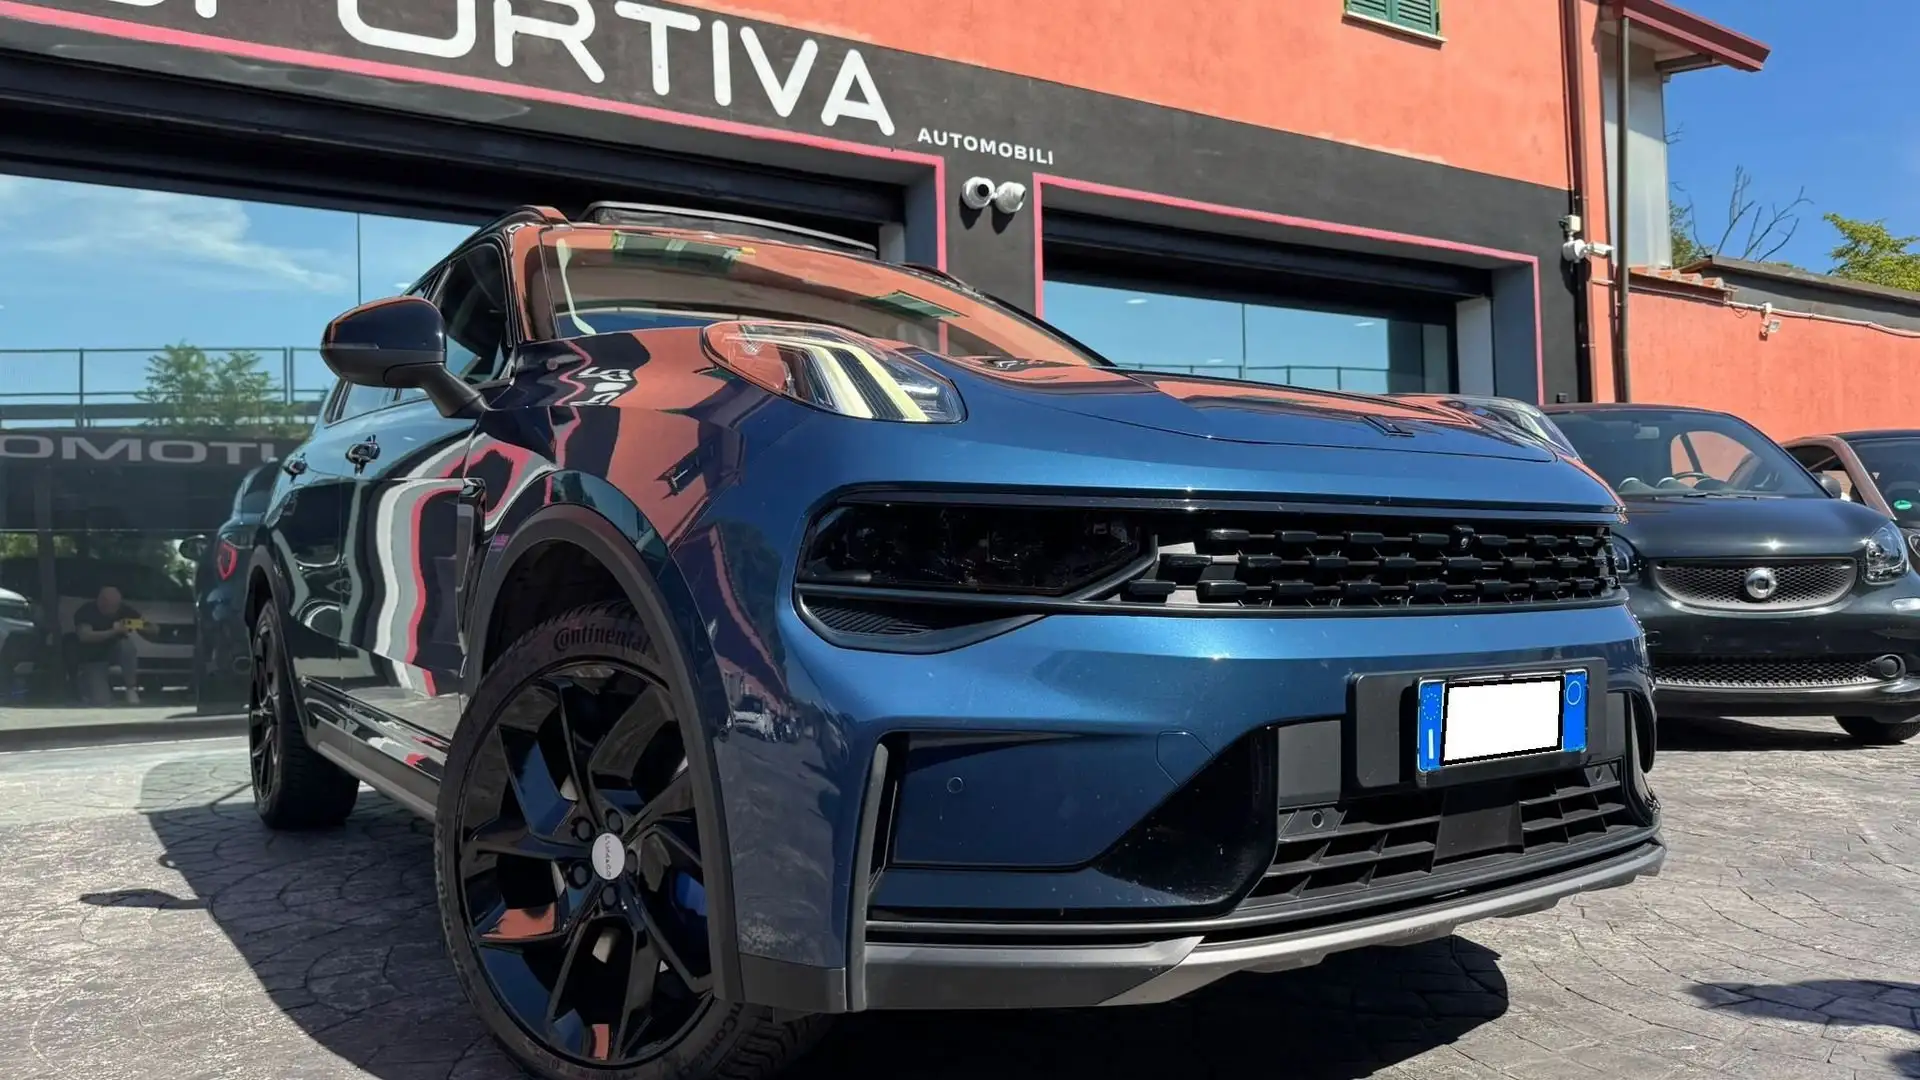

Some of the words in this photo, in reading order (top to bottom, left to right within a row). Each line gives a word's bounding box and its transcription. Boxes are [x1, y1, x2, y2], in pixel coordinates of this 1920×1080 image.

[105, 0, 897, 137] ORTIVA
[917, 127, 1054, 165] AUTOMOBILI
[553, 622, 651, 655] Continental
